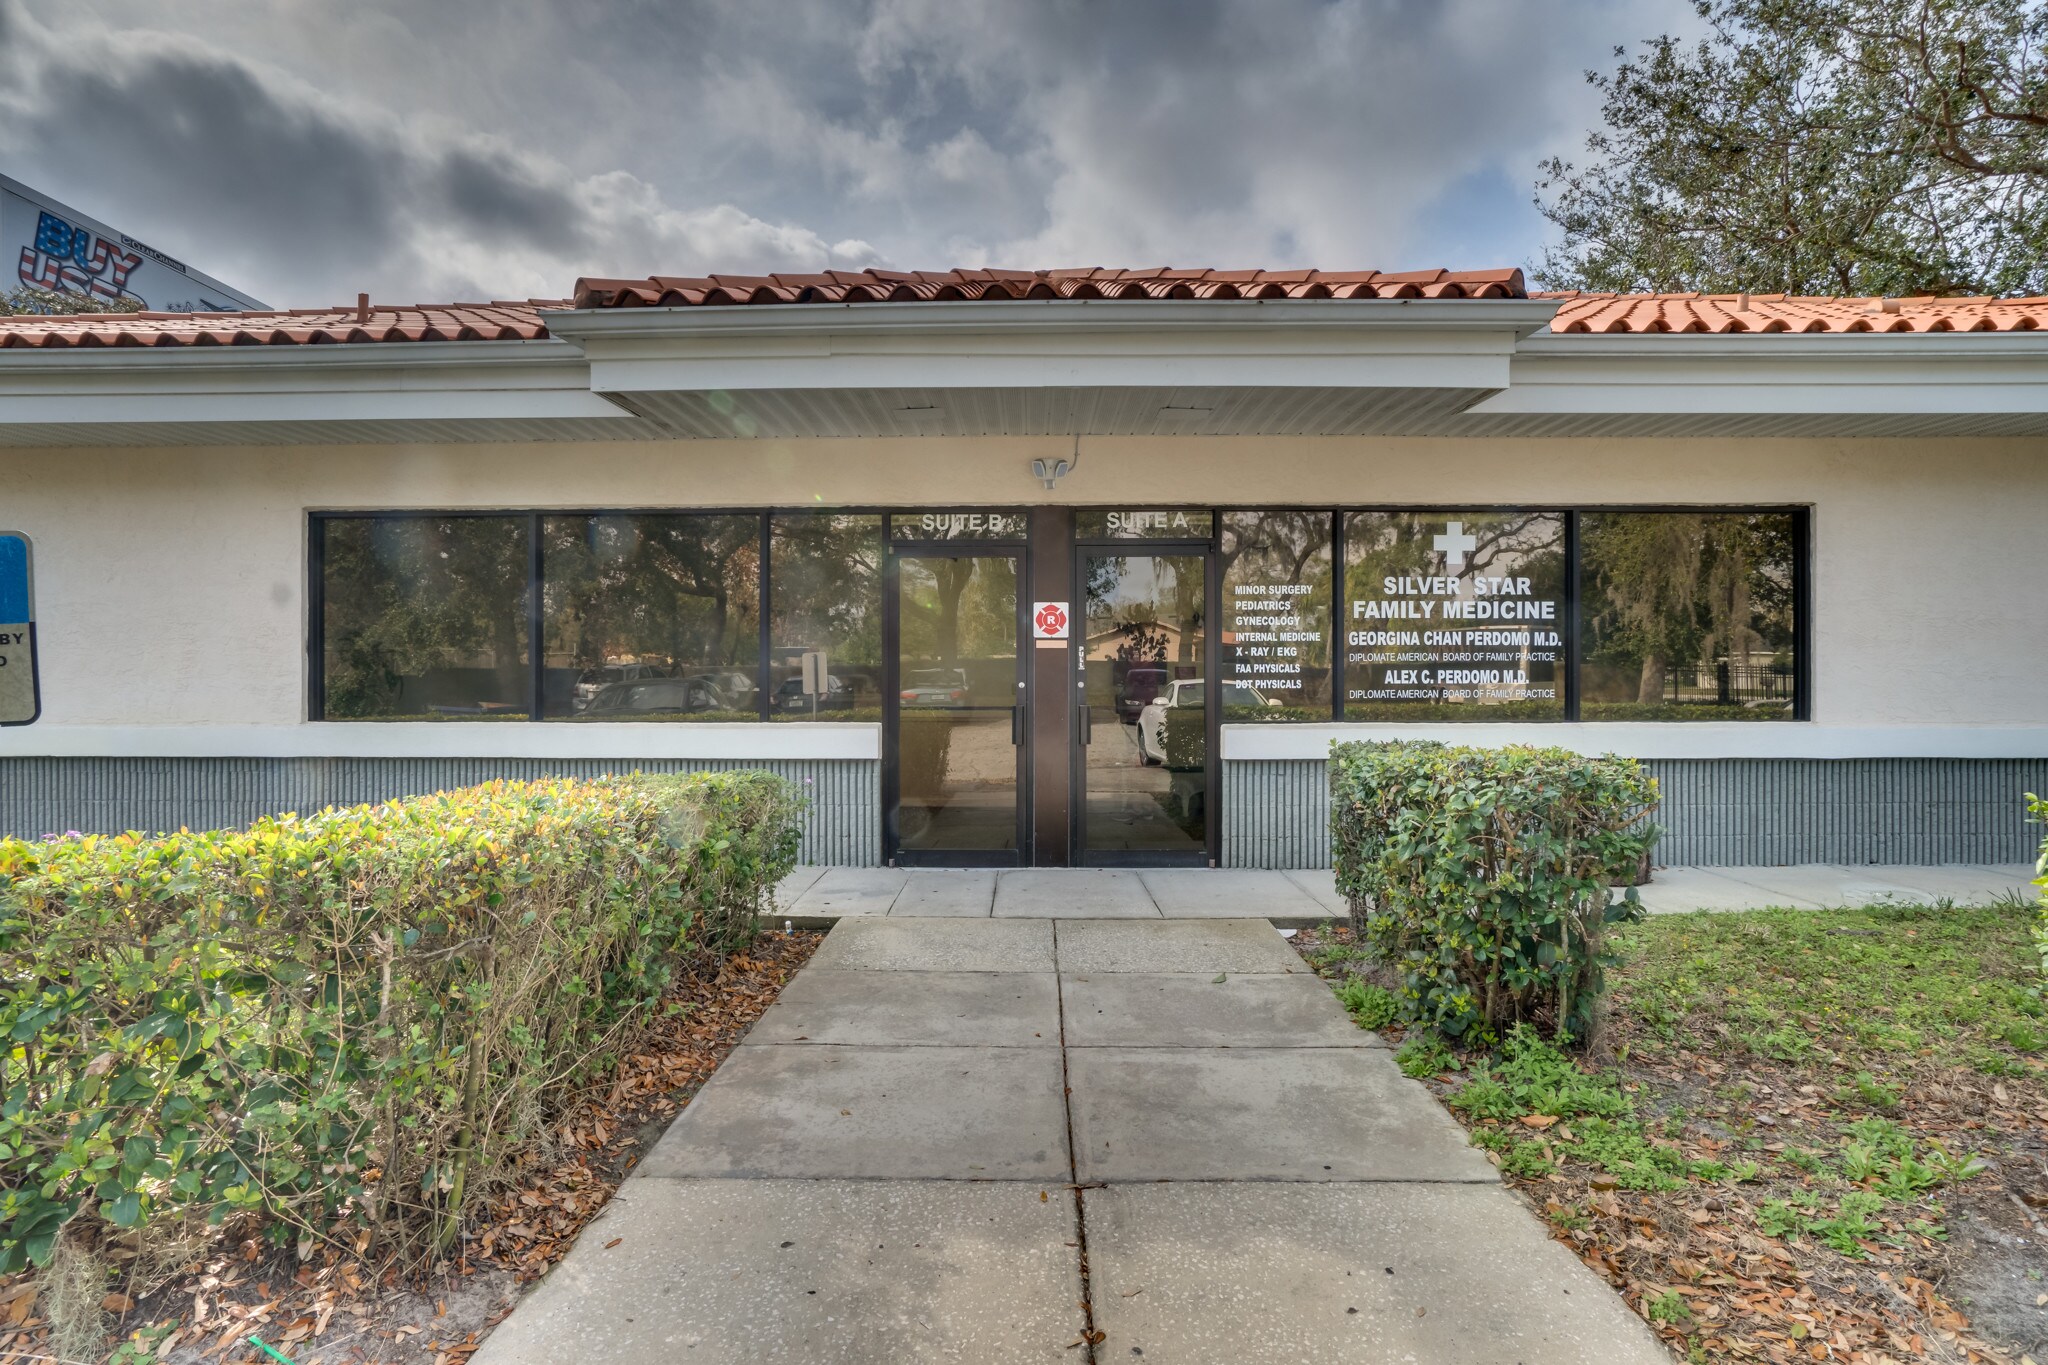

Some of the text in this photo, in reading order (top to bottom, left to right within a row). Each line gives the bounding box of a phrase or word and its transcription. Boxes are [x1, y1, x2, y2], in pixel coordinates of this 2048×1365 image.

[34, 210, 143, 287] BUY
[922, 514, 1003, 531] SUITE B
[1106, 512, 1188, 529] SUITE A
[1235, 585, 1313, 595] MINOR SURGERY
[1384, 577, 1532, 596] SILVER STAR
[1235, 601, 1291, 611] PEDIATRICS
[1353, 601, 1556, 620] FAMILY MEDICINE
[1047, 616, 1056, 625] R
[1235, 616, 1301, 626] GYNECOLOGY
[1235, 632, 1321, 642] INTERNAL MEDICINE
[1348, 631, 1420, 646] GEORGINA
[1423, 631, 1463, 646] CHAN
[1534, 631, 1562, 647] M.D.
[1236, 647, 1243, 657] X
[1250, 647, 1270, 657] RAY
[1277, 647, 1297, 657] EKG
[1349, 652, 1555, 663] DIPLOMATE AMERICAN BOARD OF FAMILY PRACTICE
[1235, 663, 1301, 673] FAA PHYSICALS
[1384, 669, 1530, 685] ALEX C. PERDOMO M.D.
[1235, 680, 1302, 689] DOT PHYSICALS
[1349, 689, 1555, 699] DIPLOMATE AMERICAN BOARD OF FAMILY PRACTICE
